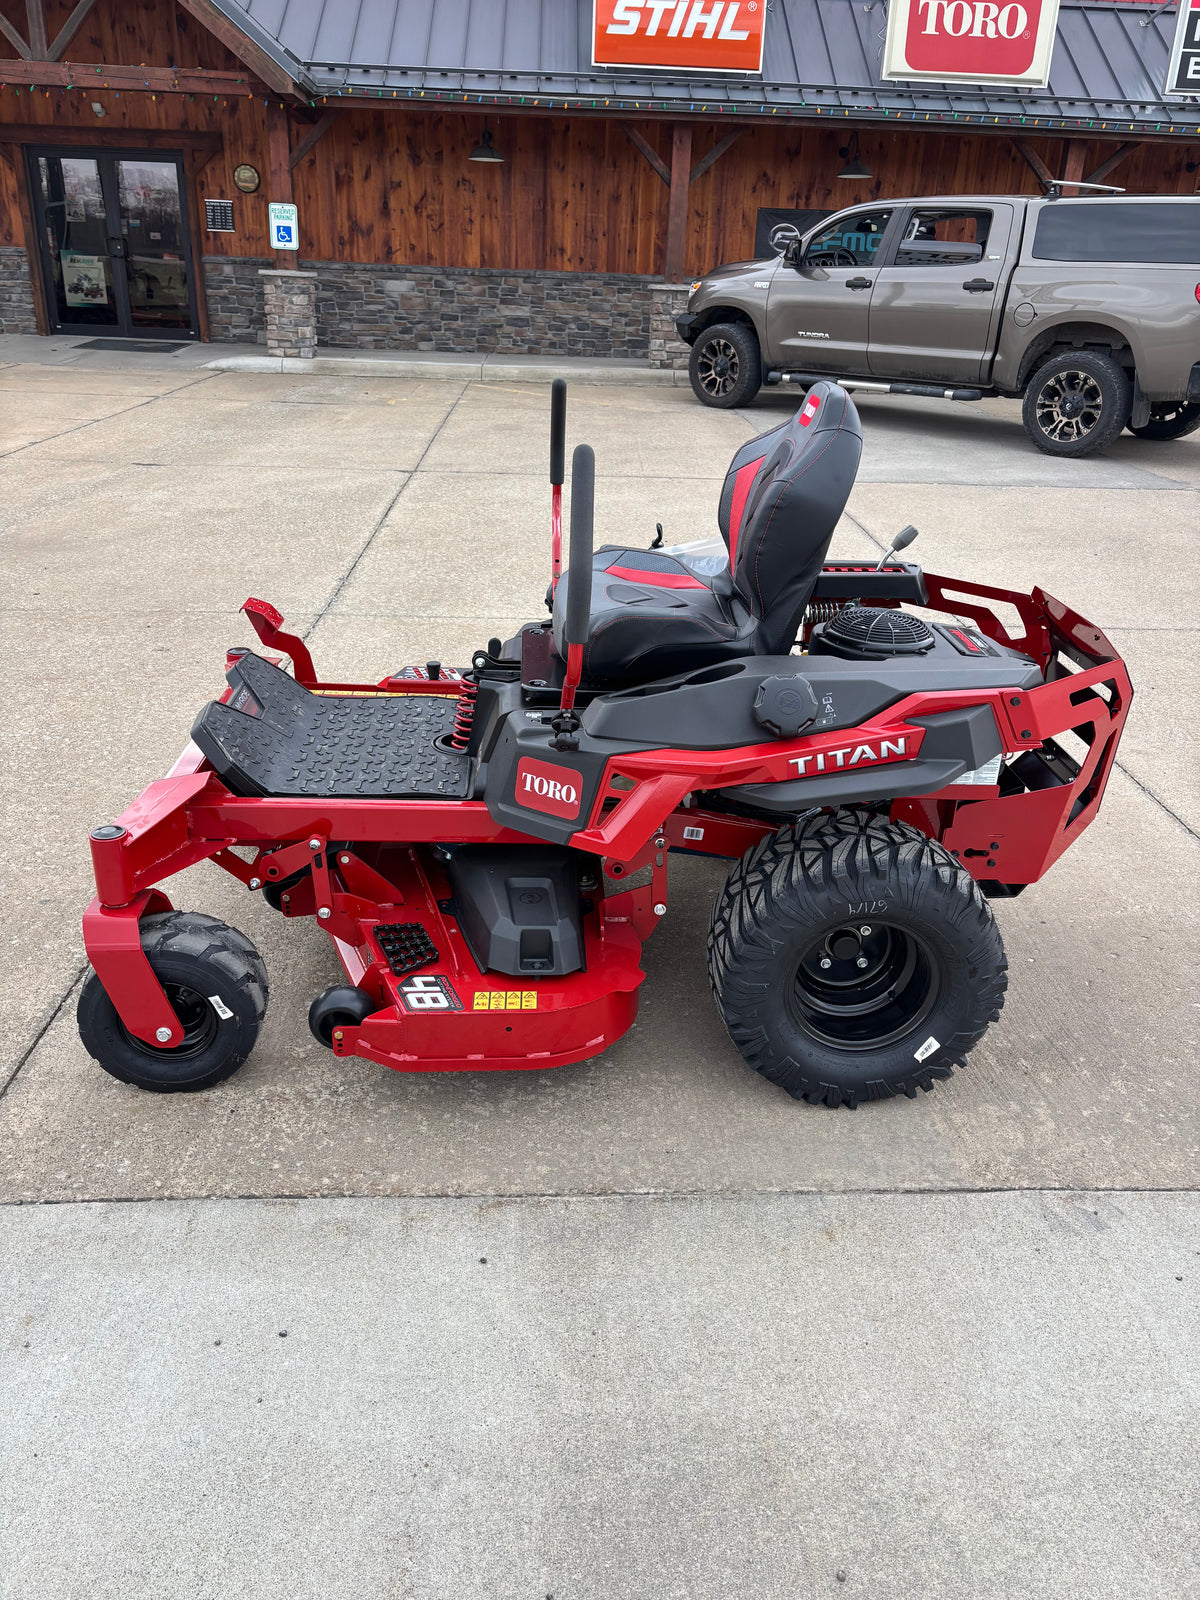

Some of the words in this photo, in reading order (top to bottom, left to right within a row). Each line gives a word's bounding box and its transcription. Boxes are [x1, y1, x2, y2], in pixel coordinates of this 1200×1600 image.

[605, 0, 750, 41] STIHL
[918, 0, 1028, 39] TORO
[797, 331, 830, 339] TUNDRA
[788, 736, 907, 775] TITAN
[521, 772, 576, 803] TORO
[401, 976, 450, 1009] 48
